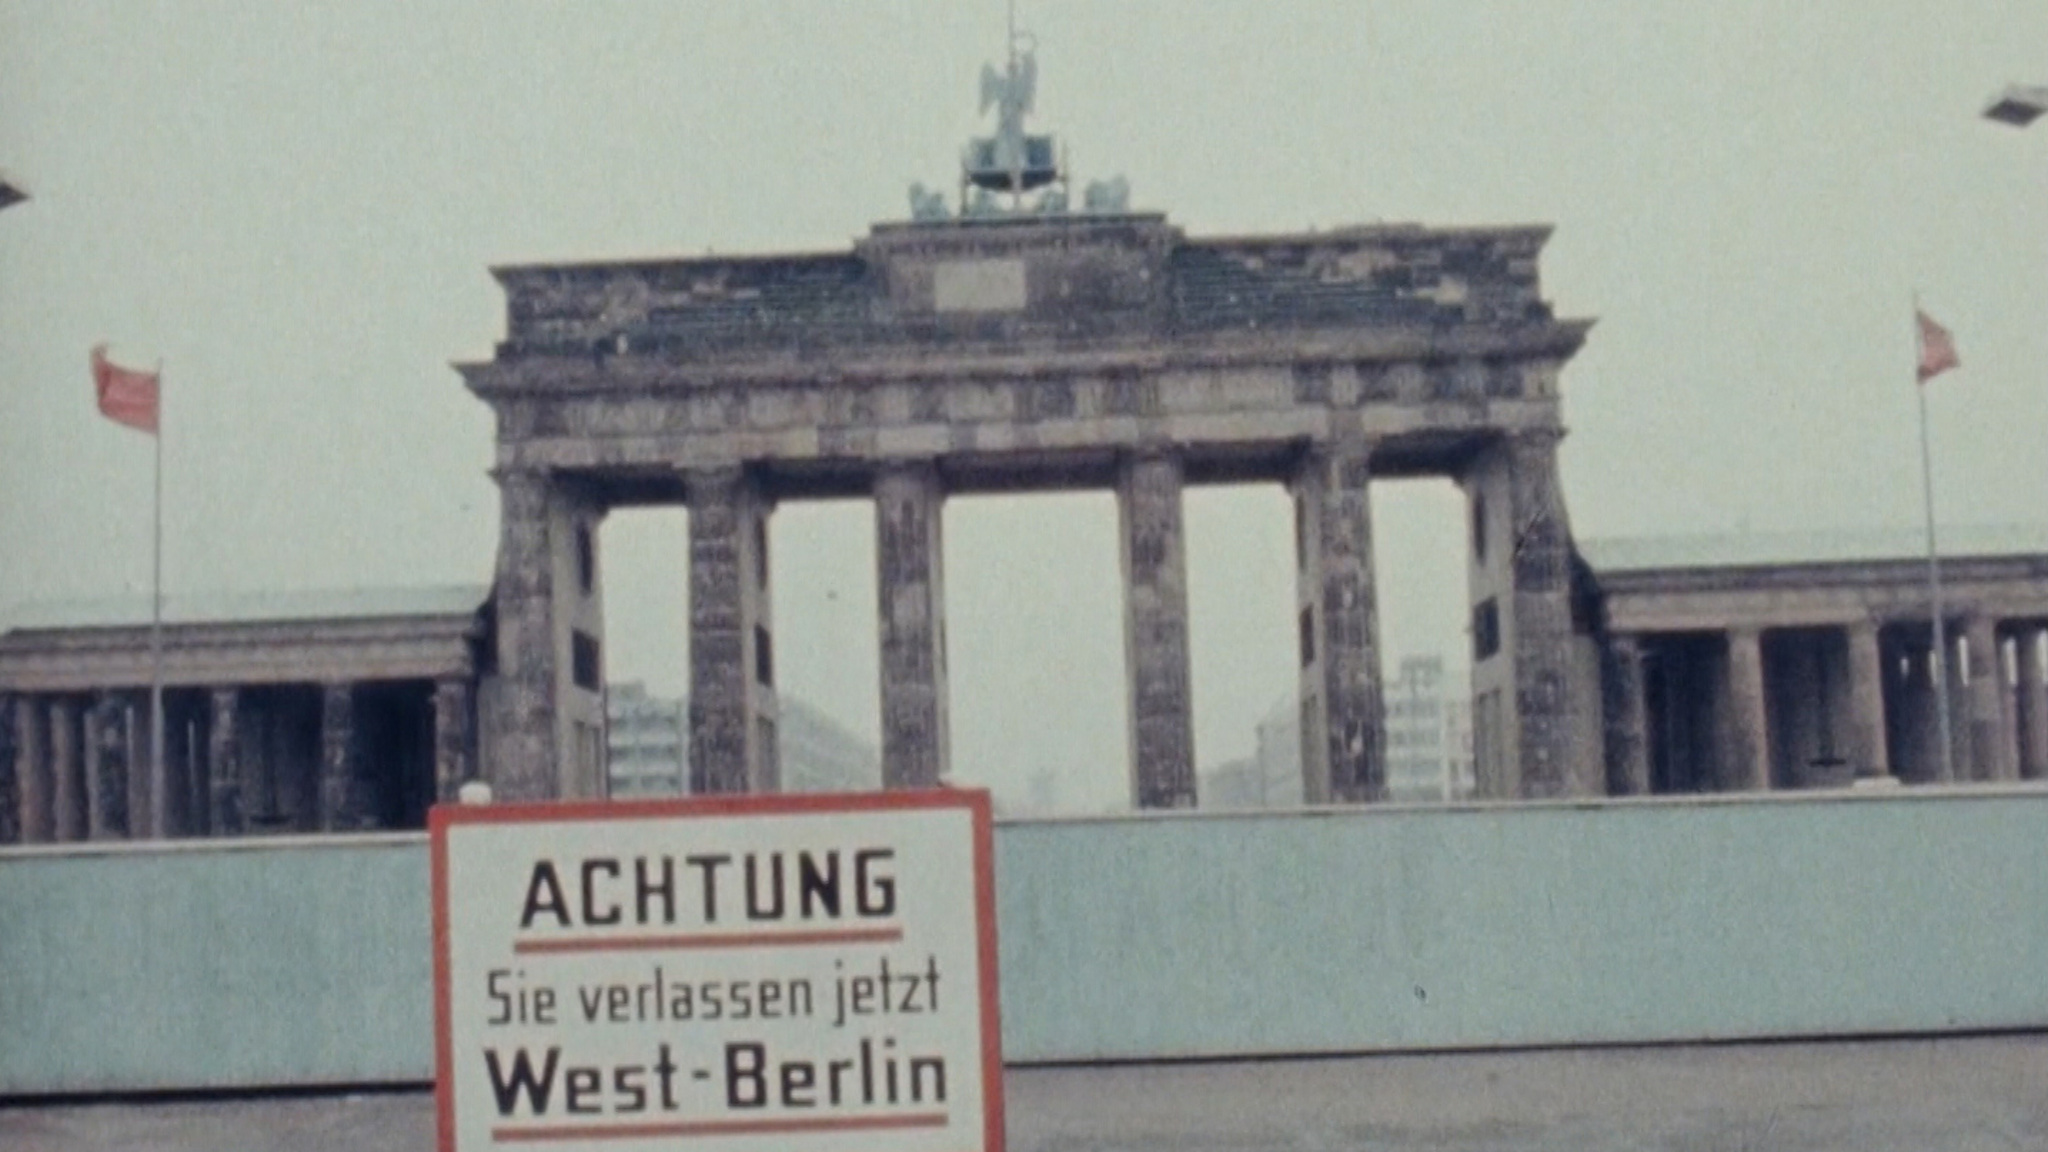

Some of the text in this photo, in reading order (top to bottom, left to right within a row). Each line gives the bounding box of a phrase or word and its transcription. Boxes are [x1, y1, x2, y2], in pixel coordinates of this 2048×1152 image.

[520, 848, 897, 929] ACHTUNG
[487, 955, 941, 1027] Sie verlassen jetzt
[484, 1037, 948, 1117] West-Berlin
